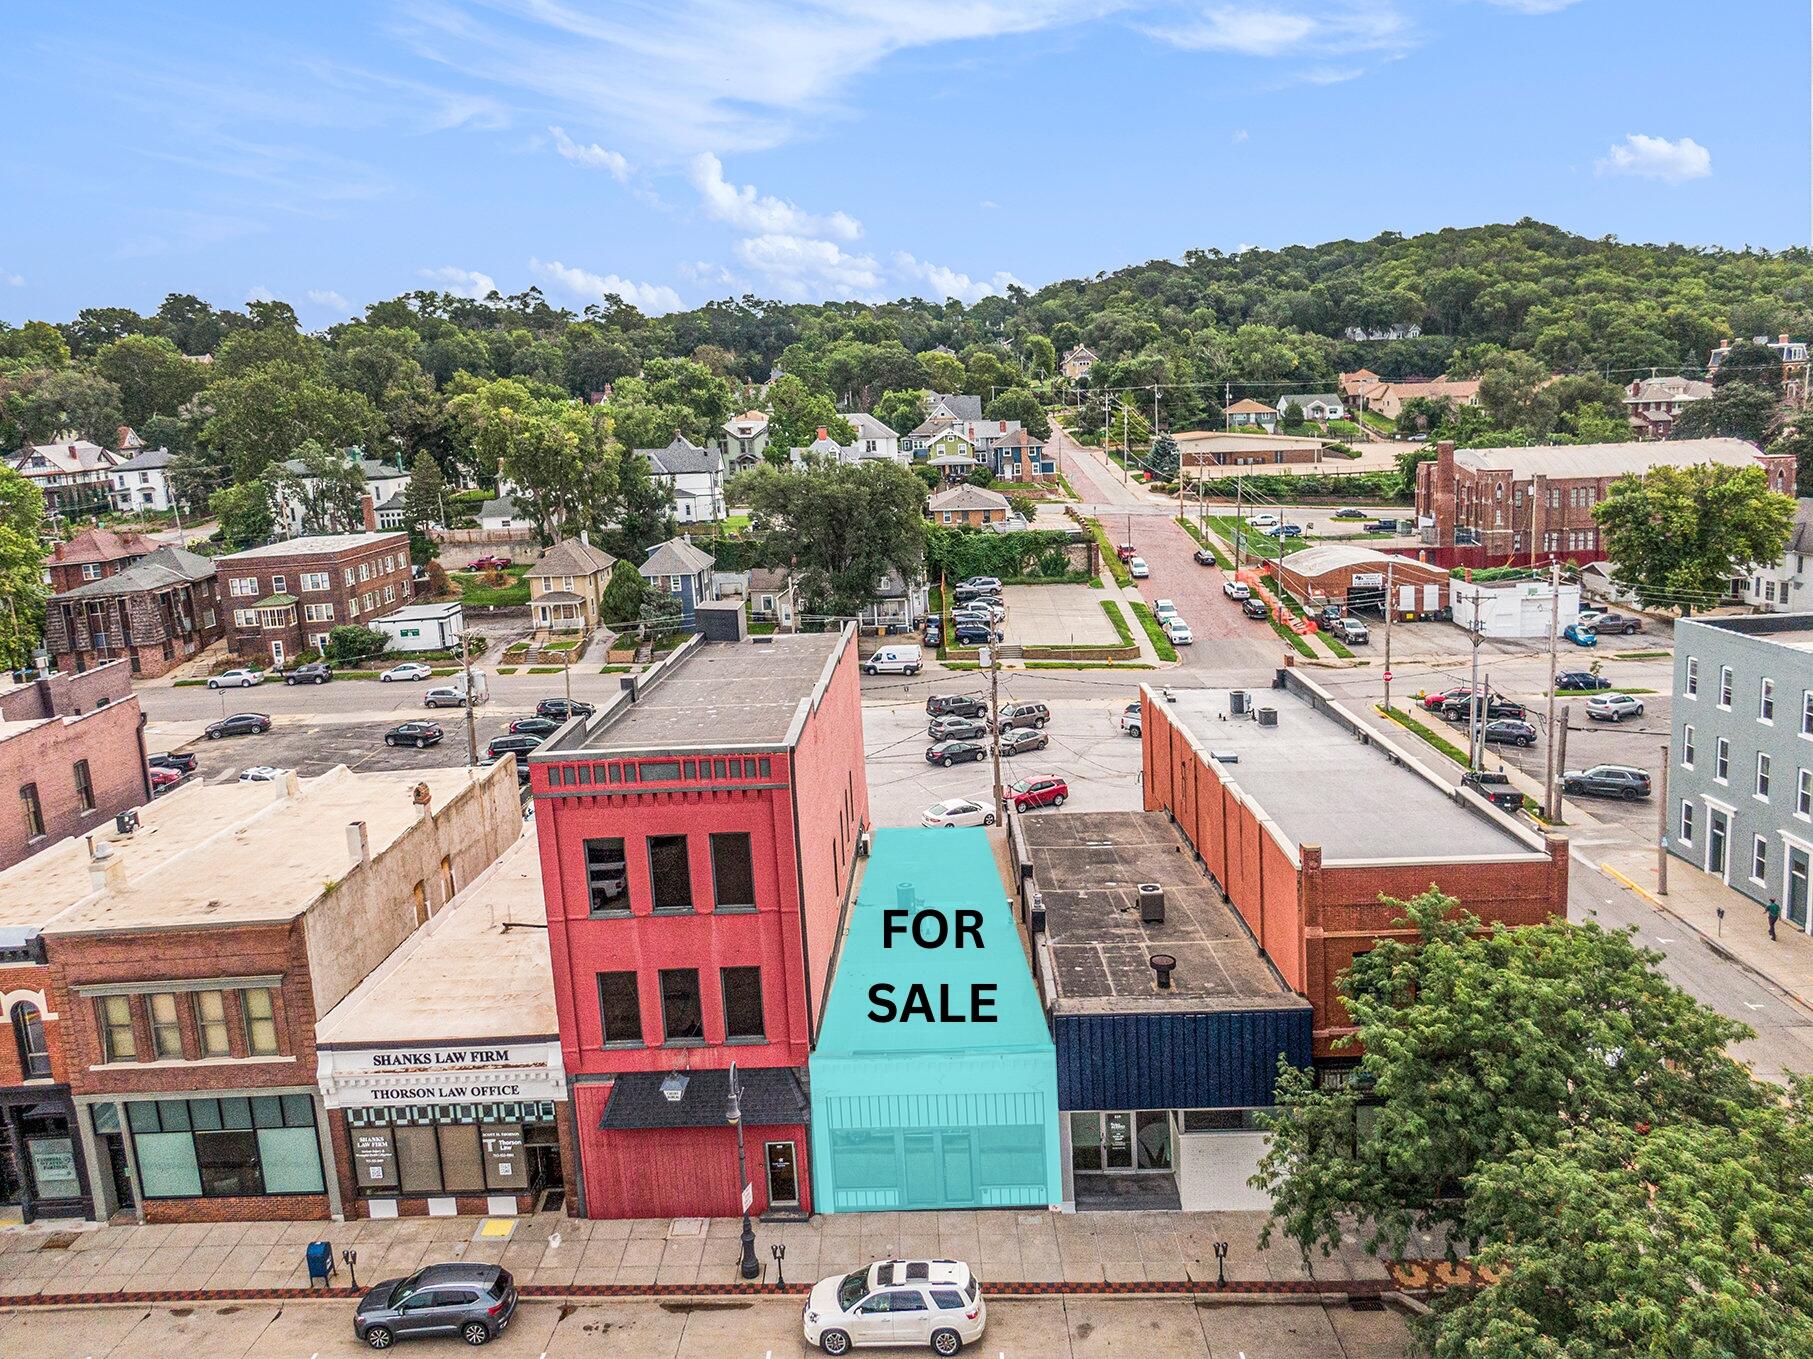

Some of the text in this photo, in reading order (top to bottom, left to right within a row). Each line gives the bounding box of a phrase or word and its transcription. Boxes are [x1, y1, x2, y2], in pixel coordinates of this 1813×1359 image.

[373, 1050, 509, 1066] SHANKS LAW FIRM
[371, 1084, 520, 1100] THORSON LAW OFFICE
